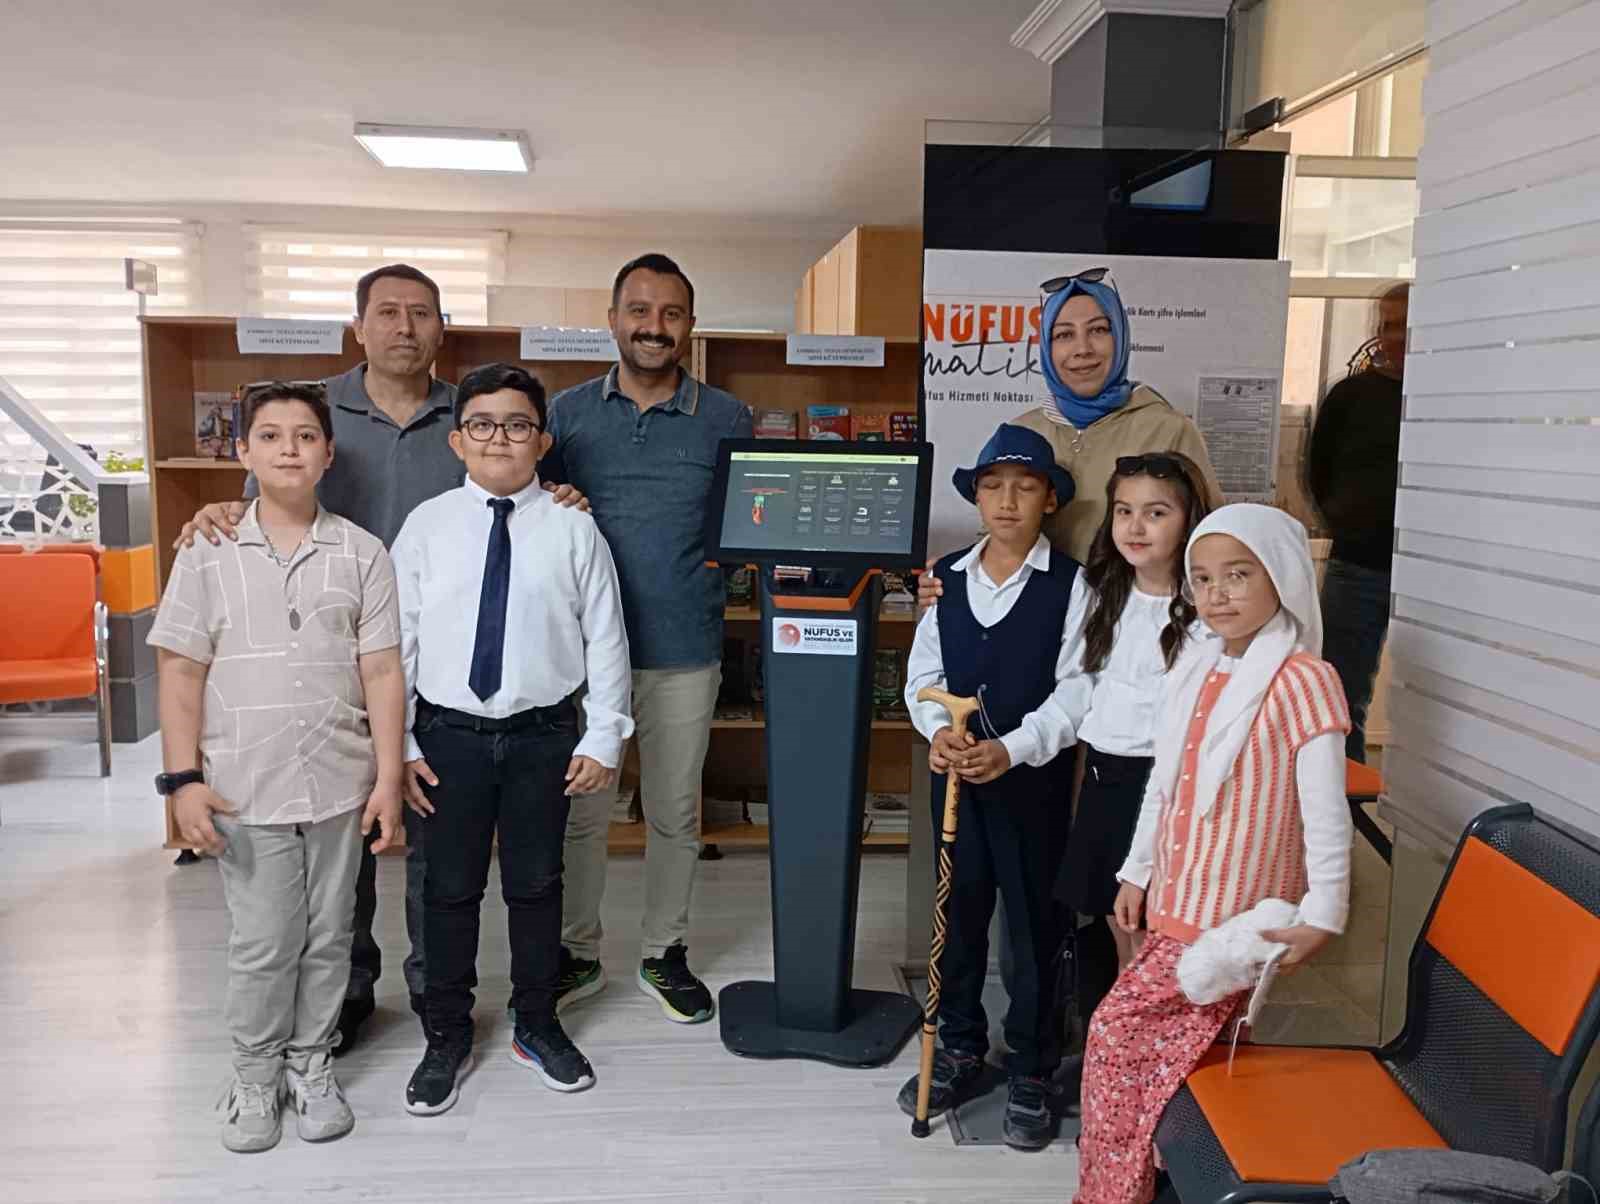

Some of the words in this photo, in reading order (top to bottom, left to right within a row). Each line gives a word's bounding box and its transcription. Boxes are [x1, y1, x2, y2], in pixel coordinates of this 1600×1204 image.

[927, 390, 945, 401] fus
[949, 390, 989, 402] Hizmeti
[993, 391, 1034, 402] Noktası
[841, 630, 854, 638] VE
